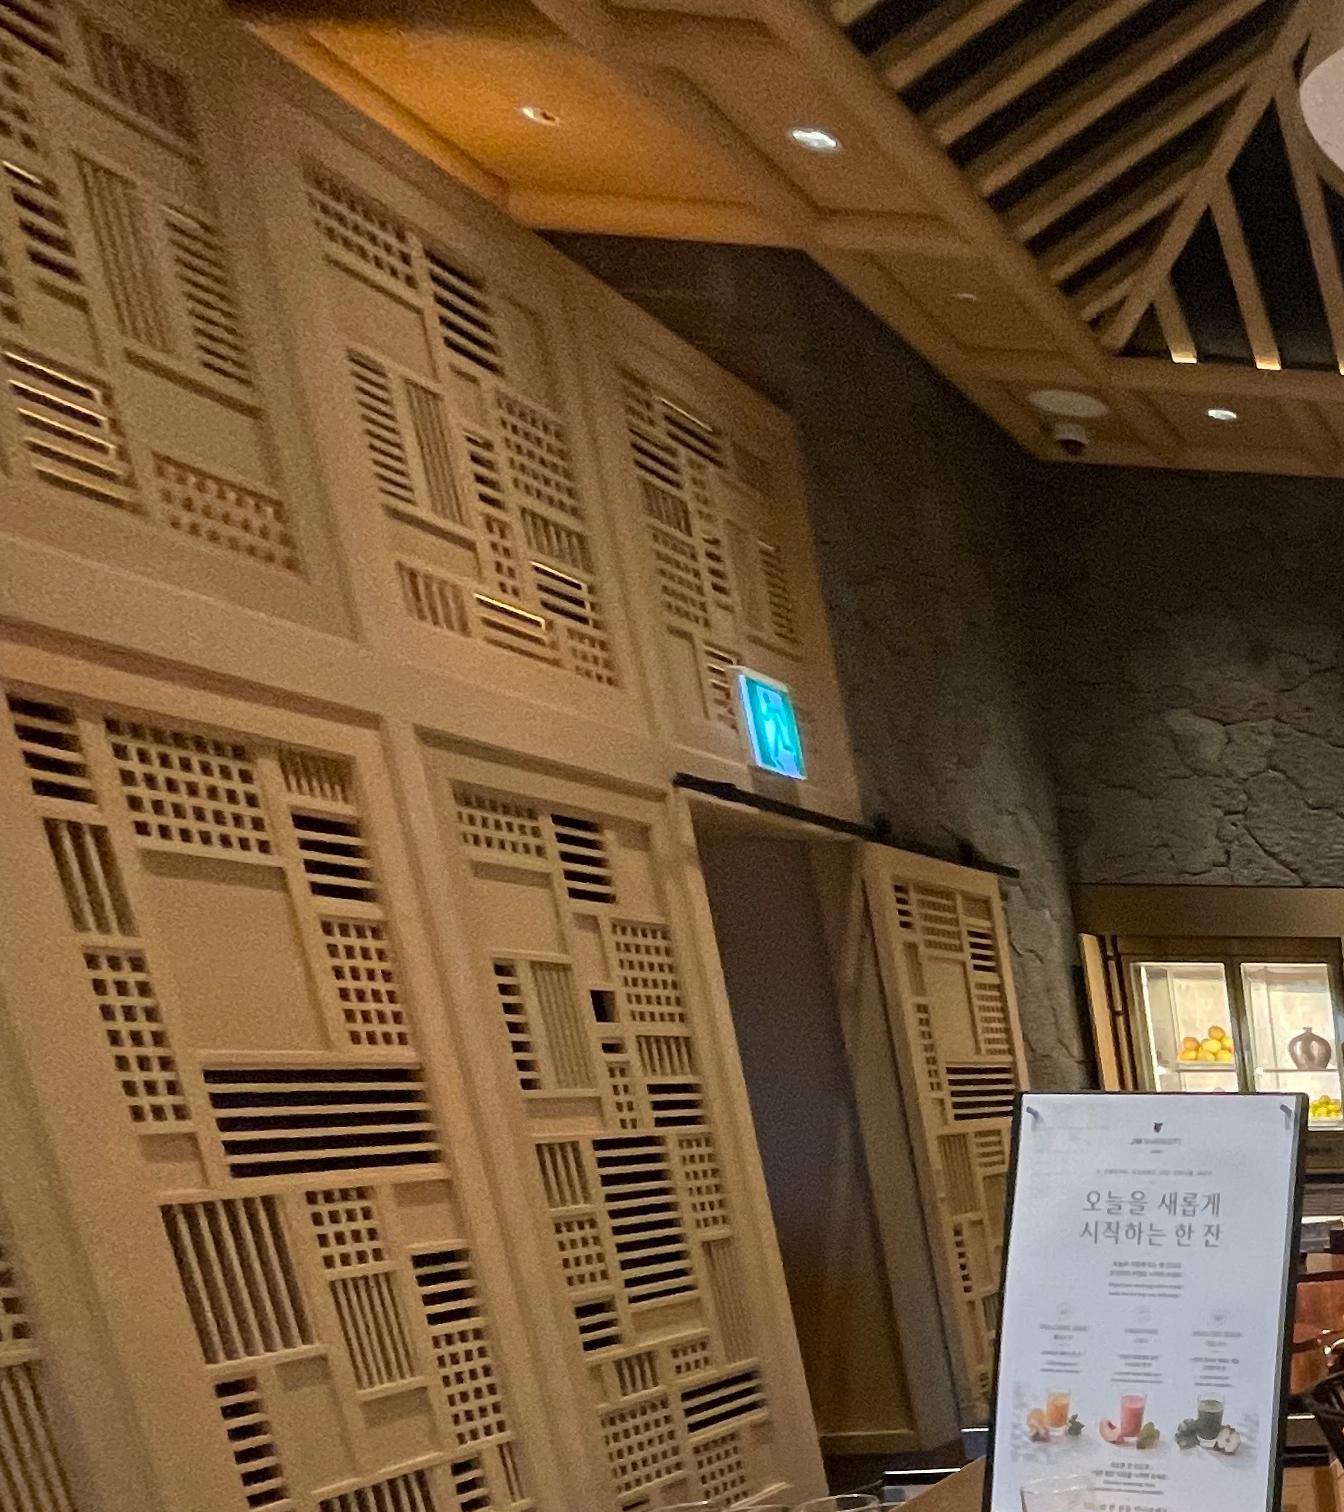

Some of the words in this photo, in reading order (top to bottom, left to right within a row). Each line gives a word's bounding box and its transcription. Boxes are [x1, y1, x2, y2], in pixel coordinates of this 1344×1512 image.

[1082, 1190, 1149, 1216] 오늘을
[1158, 1191, 1221, 1217] 새롭게
[1079, 1220, 1168, 1247] 시작하는
[1175, 1222, 1195, 1247] 한
[1202, 1223, 1224, 1248] 잔
